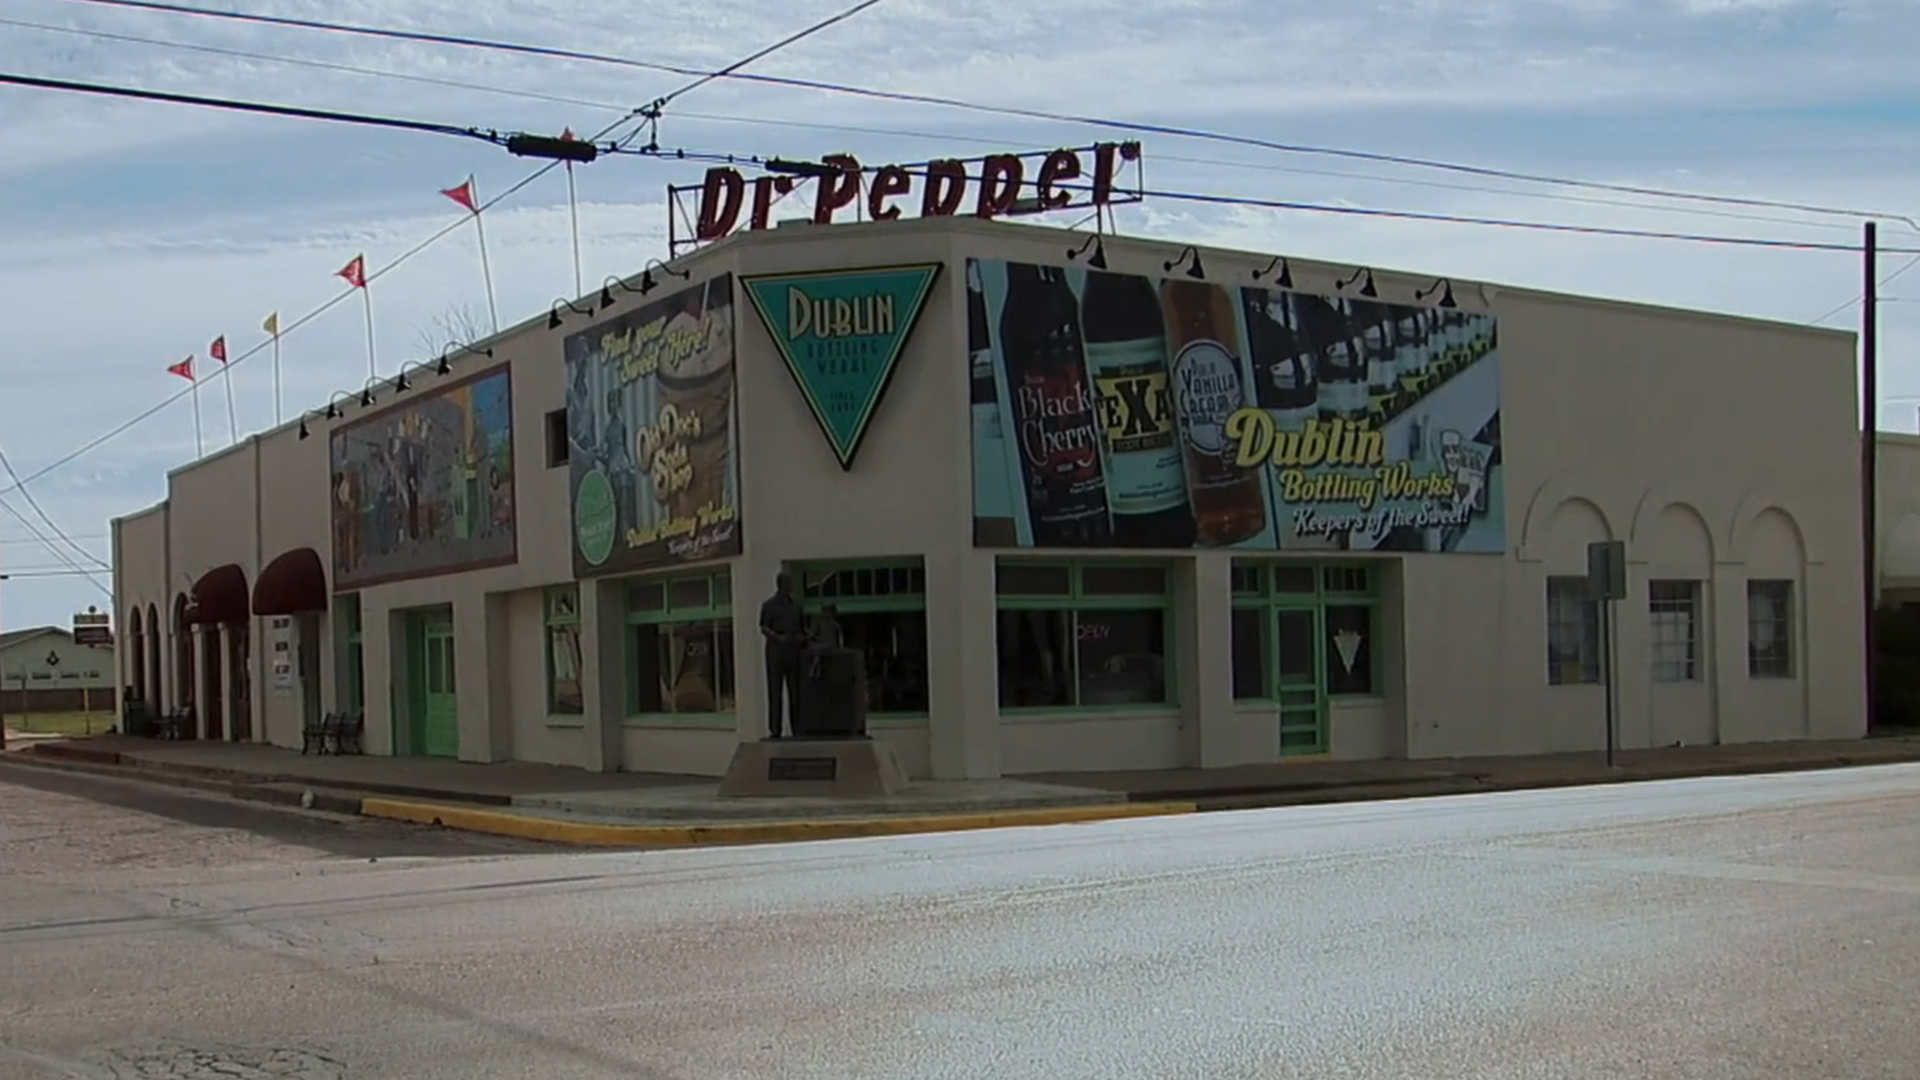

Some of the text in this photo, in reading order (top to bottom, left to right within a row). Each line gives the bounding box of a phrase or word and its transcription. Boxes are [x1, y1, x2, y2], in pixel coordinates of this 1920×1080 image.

[698, 141, 1140, 240] Dr Pepper
[789, 286, 894, 340] DUBLIN
[1018, 380, 1092, 419] Black
[1181, 369, 1235, 395] VANILLA
[1095, 379, 1174, 437] TEXA
[1022, 420, 1096, 467] Cherry
[1226, 407, 1384, 466] Dublin
[1280, 470, 1376, 509] Bottling
[1376, 461, 1454, 498] Works
[1293, 506, 1364, 537] Keepers
[1365, 510, 1387, 538] of
[1388, 506, 1415, 528] the
